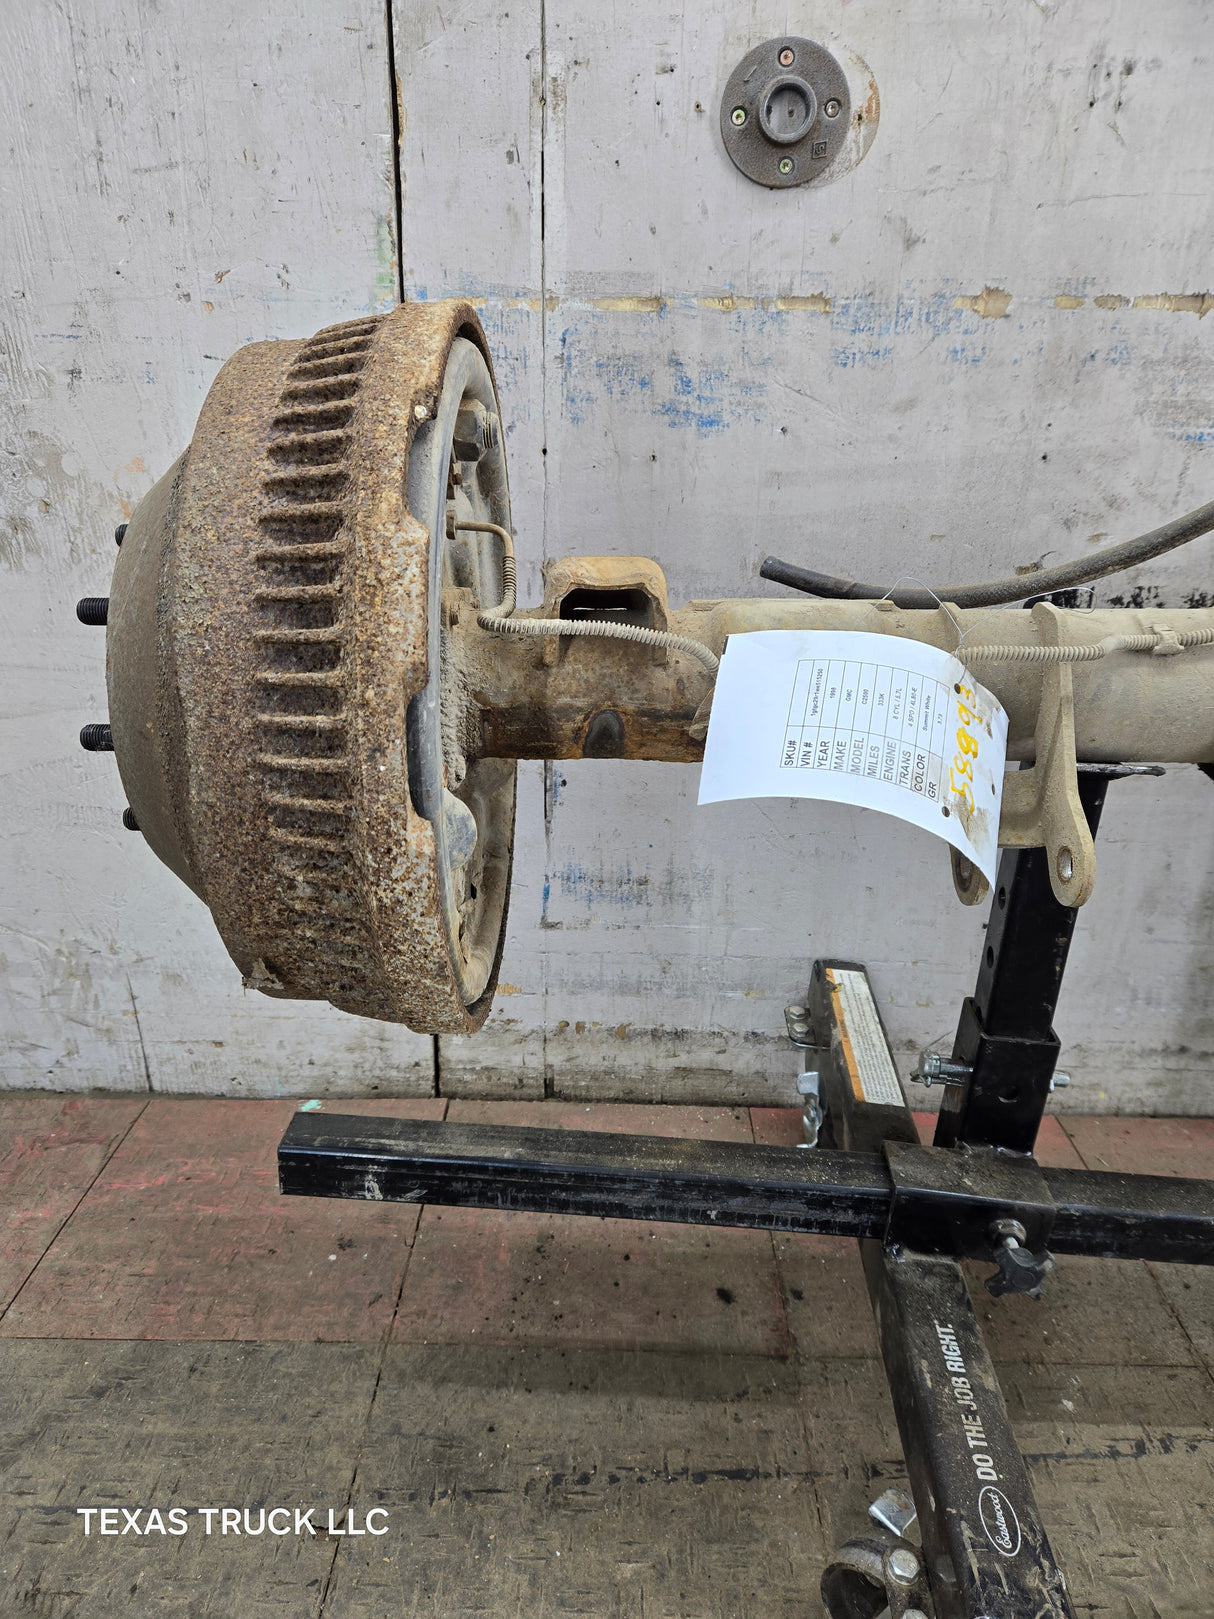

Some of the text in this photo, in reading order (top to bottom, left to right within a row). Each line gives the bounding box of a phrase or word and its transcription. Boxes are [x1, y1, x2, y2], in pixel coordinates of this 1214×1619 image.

[845, 689, 853, 702] GMC
[861, 689, 869, 705] C2500
[785, 740, 797, 766] SKU#
[800, 750, 812, 767] VIN
[817, 740, 830, 768] YEAR
[834, 740, 847, 770] MAKE
[850, 737, 864, 773] MODEL
[867, 745, 880, 777] MILES
[883, 741, 897, 781] ENGINE
[899, 750, 911, 785] TRANS
[914, 753, 926, 792] COLOR
[928, 782, 937, 798] GR
[935, 1323, 998, 1481] DO THE JOB RIGHT.
[987, 1492, 1012, 1549] Eastwood
